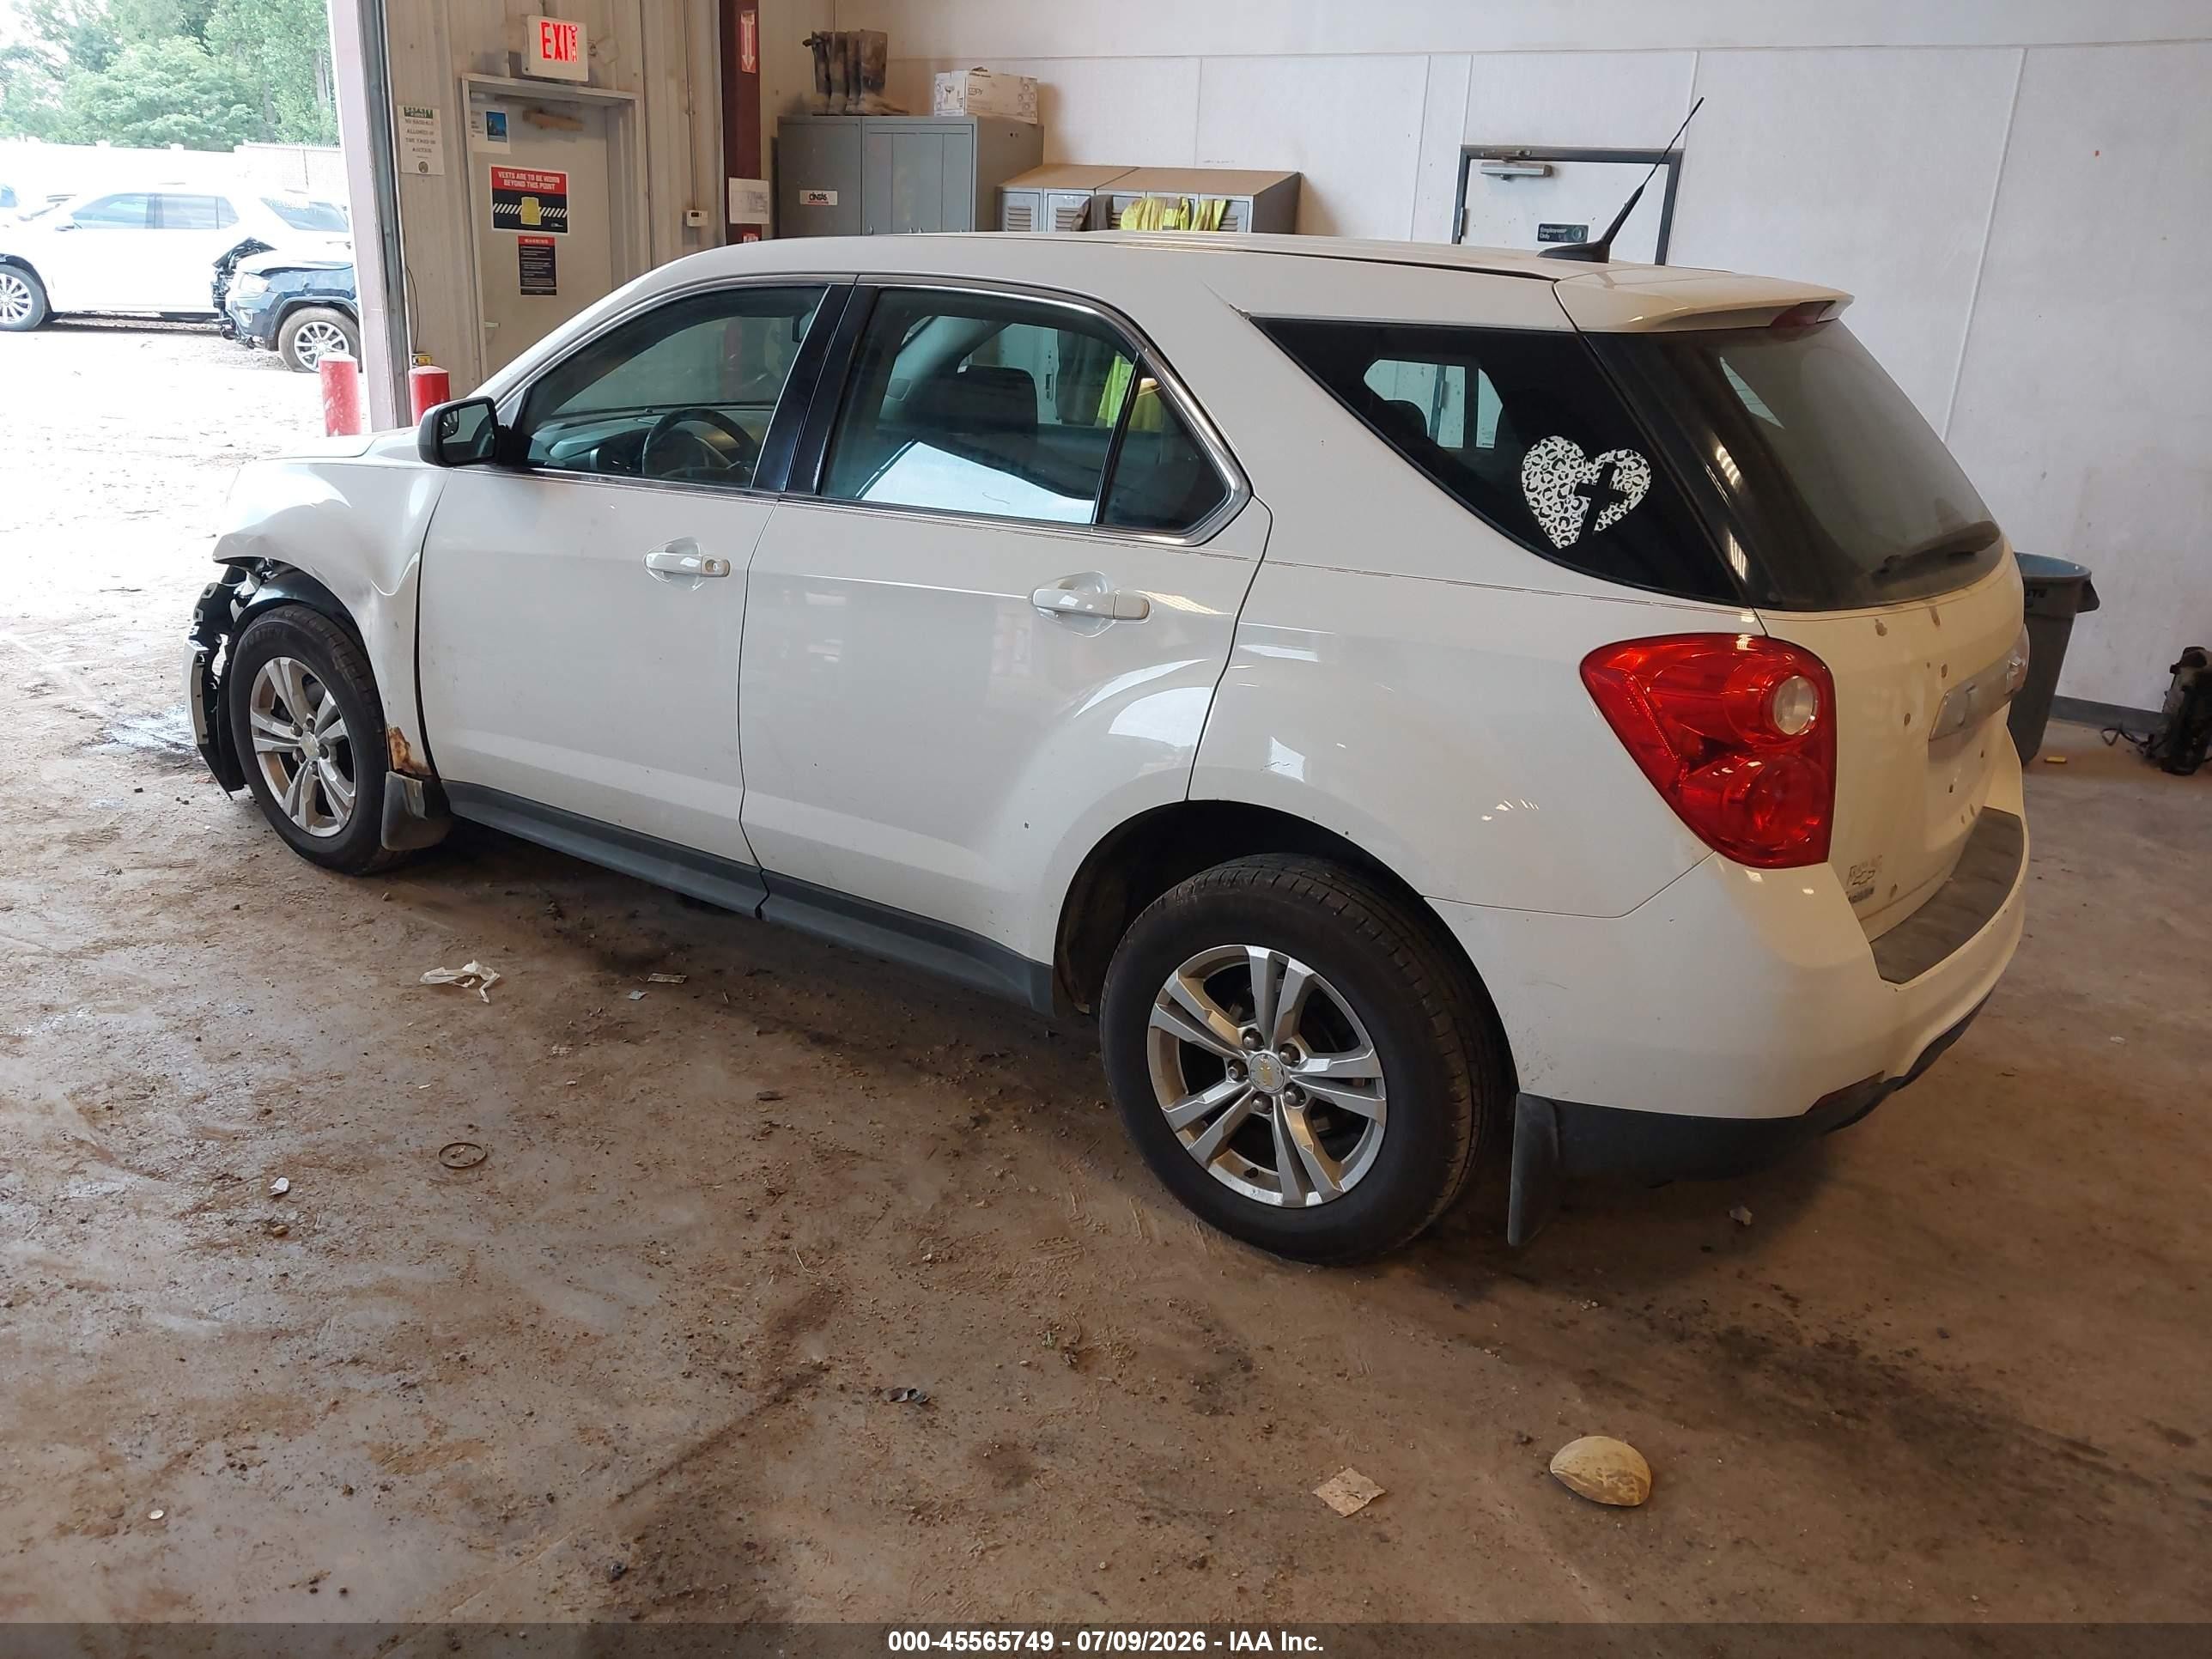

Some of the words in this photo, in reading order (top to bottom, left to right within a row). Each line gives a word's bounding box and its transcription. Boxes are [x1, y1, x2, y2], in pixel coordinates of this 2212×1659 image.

[498, 171, 515, 179] VESTS
[503, 179, 526, 187] BEYOND
[539, 182, 556, 191] POINT
